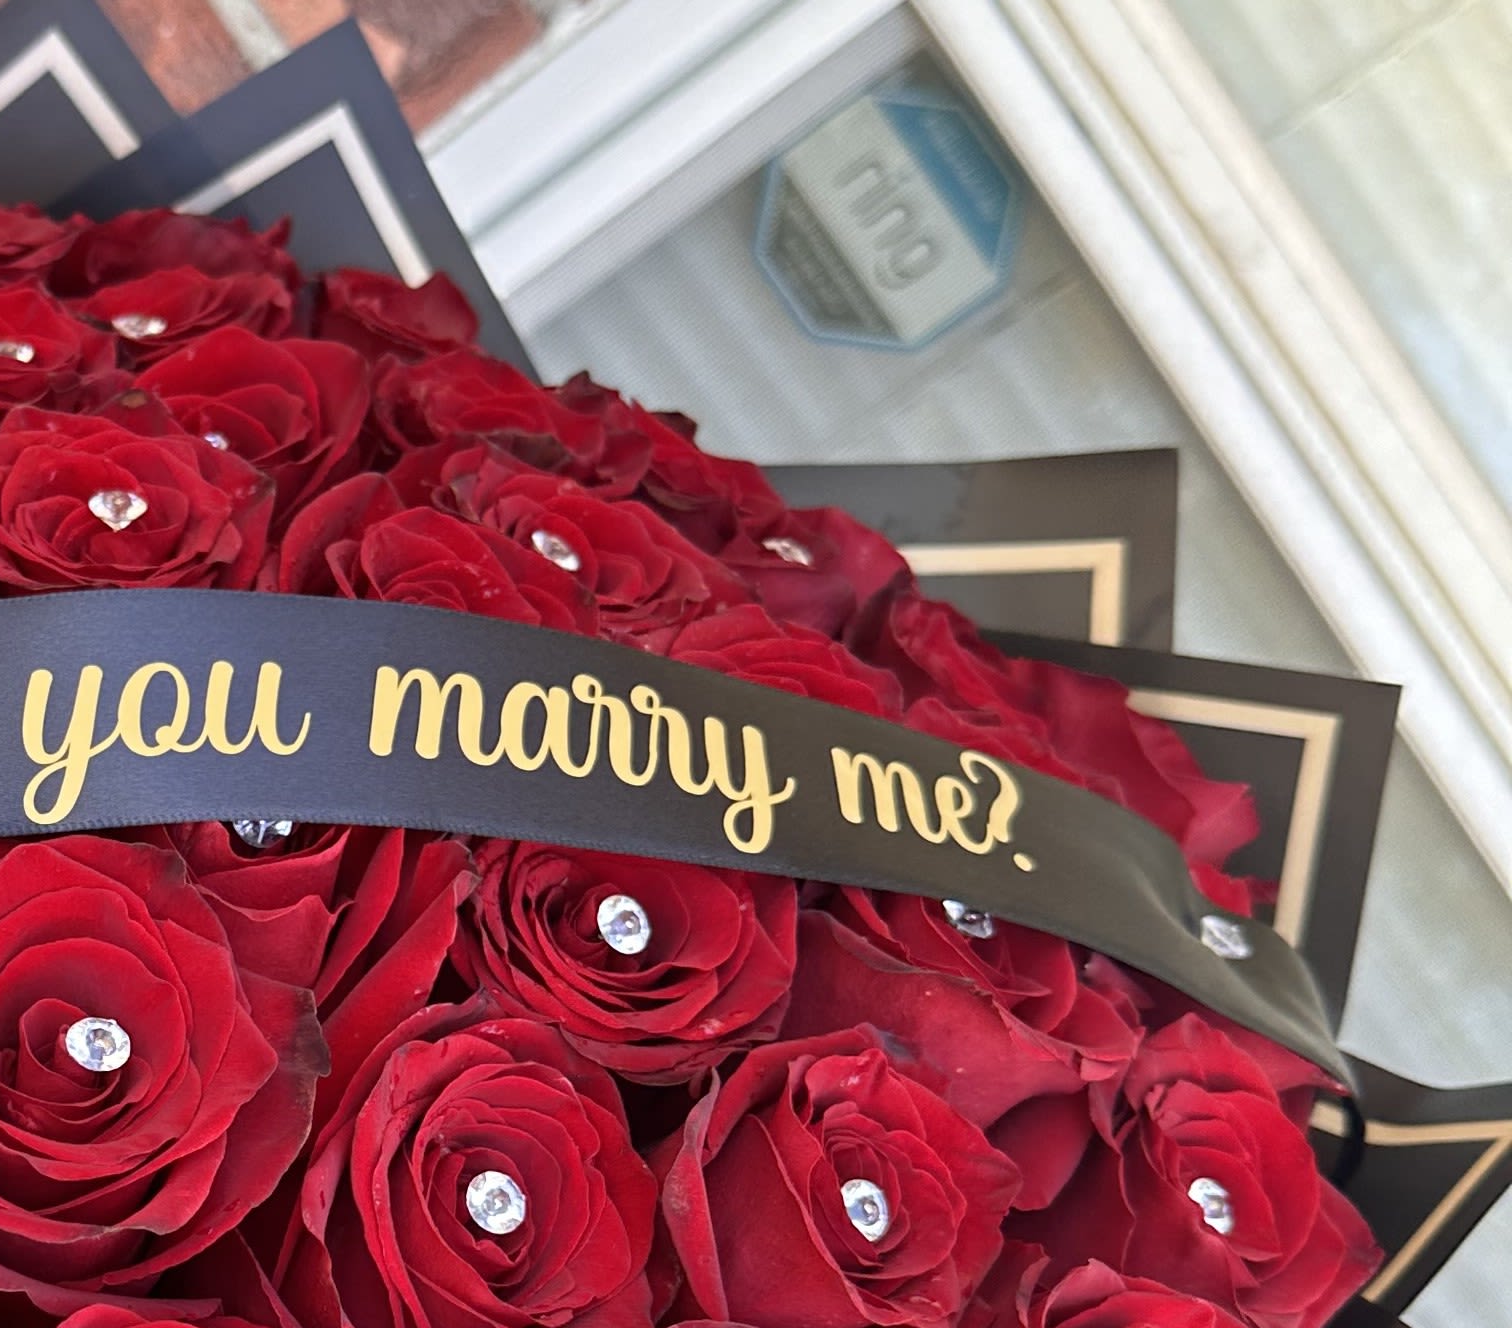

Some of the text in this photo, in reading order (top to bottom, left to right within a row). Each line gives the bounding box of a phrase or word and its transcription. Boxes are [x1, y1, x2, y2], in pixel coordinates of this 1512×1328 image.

[836, 155, 945, 291] ring
[21, 660, 312, 825] you
[368, 665, 797, 855] marry
[830, 747, 1038, 873] me?
